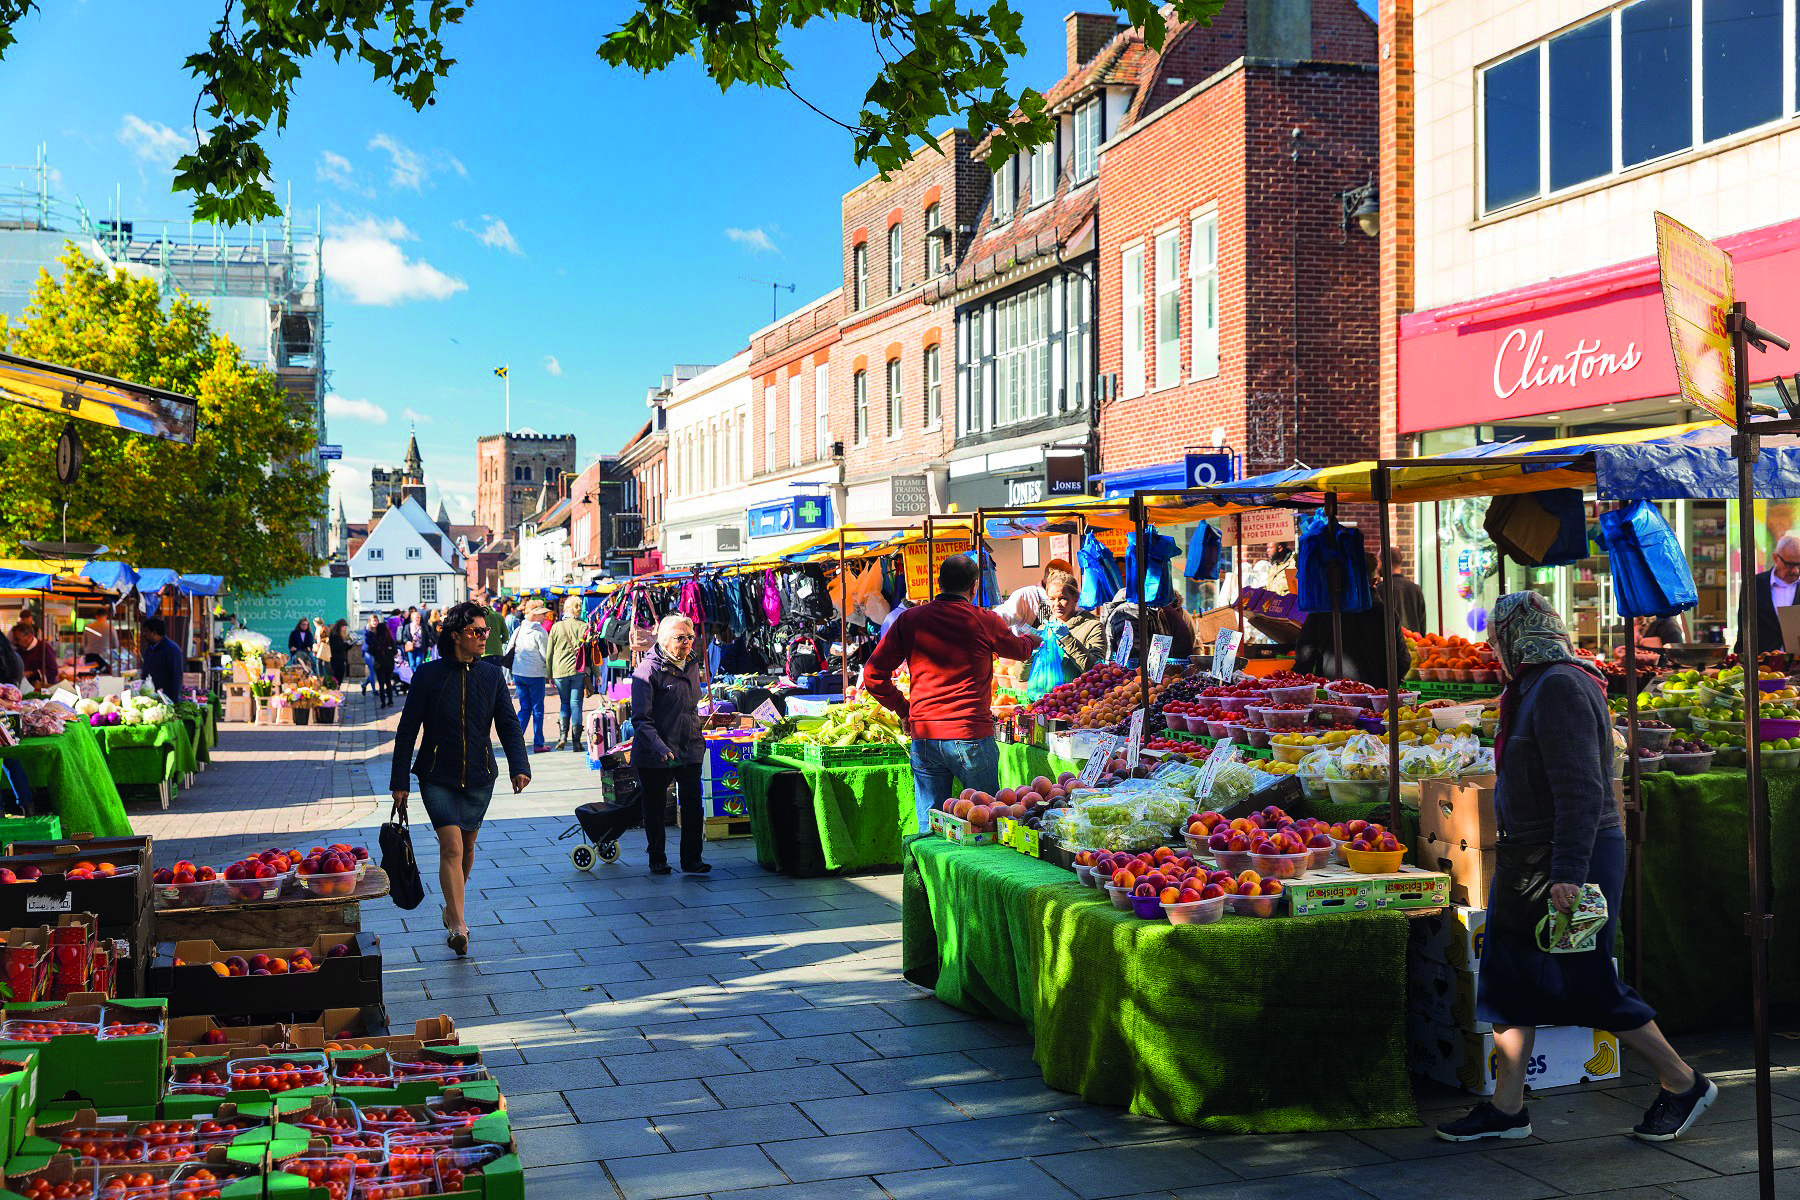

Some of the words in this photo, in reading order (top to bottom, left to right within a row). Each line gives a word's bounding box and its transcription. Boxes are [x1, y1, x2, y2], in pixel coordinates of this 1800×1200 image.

[1494, 328, 1642, 399] Clintons
[1052, 480, 1082, 491] JONES
[895, 493, 926, 502] COOK
[1005, 480, 1043, 507] JONES
[895, 503, 927, 512] SHOP
[1265, 521, 1289, 530] REPAIRS
[1247, 531, 1259, 539] FOR
[1260, 529, 1283, 538] DETAILS
[935, 541, 971, 554] BATTERIE
[267, 596, 281, 607] do
[284, 598, 303, 608] you
[305, 596, 327, 607] love
[269, 609, 281, 620] St
[1423, 881, 1436, 891] AC
[1346, 887, 1359, 897] AC
